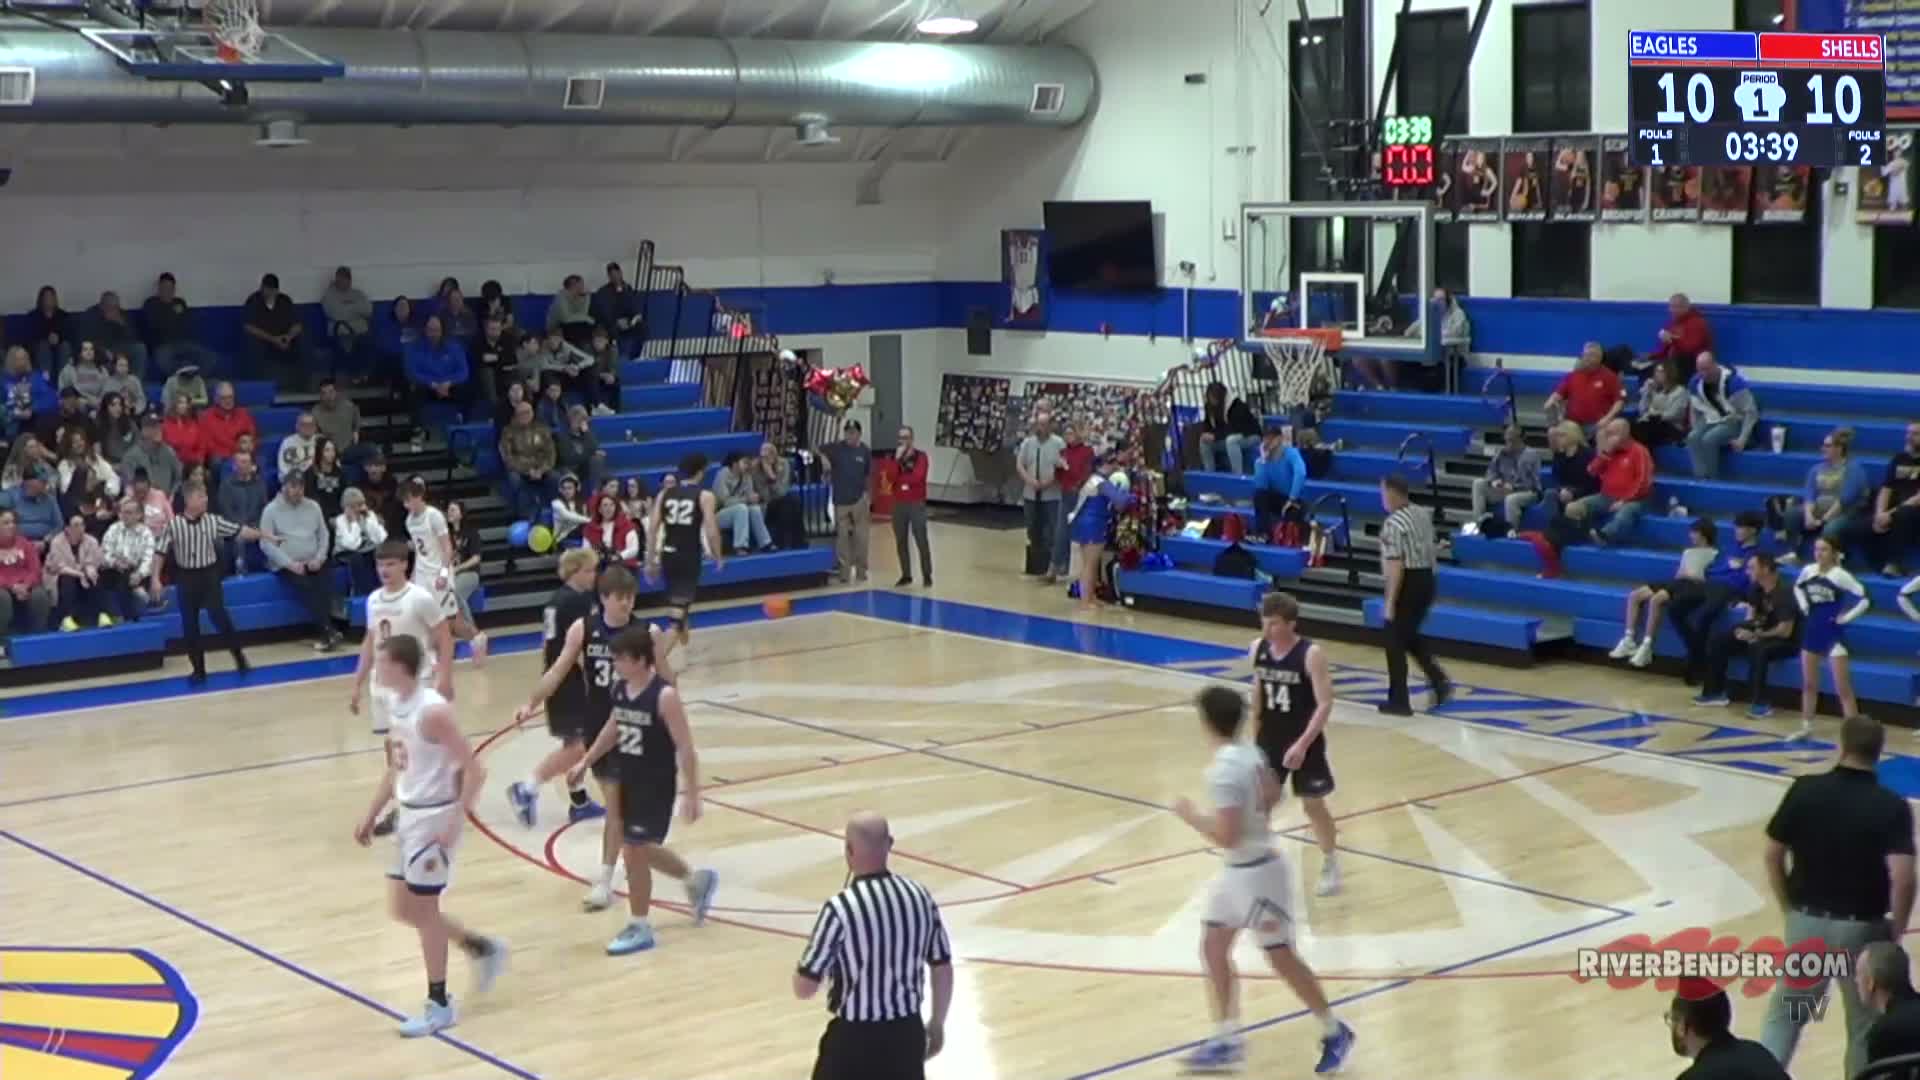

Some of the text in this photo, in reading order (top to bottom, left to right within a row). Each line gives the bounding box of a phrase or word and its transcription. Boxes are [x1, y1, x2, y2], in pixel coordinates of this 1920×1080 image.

[665, 498, 695, 526] 32
[1264, 683, 1291, 713] 14
[616, 724, 643, 756] 22
